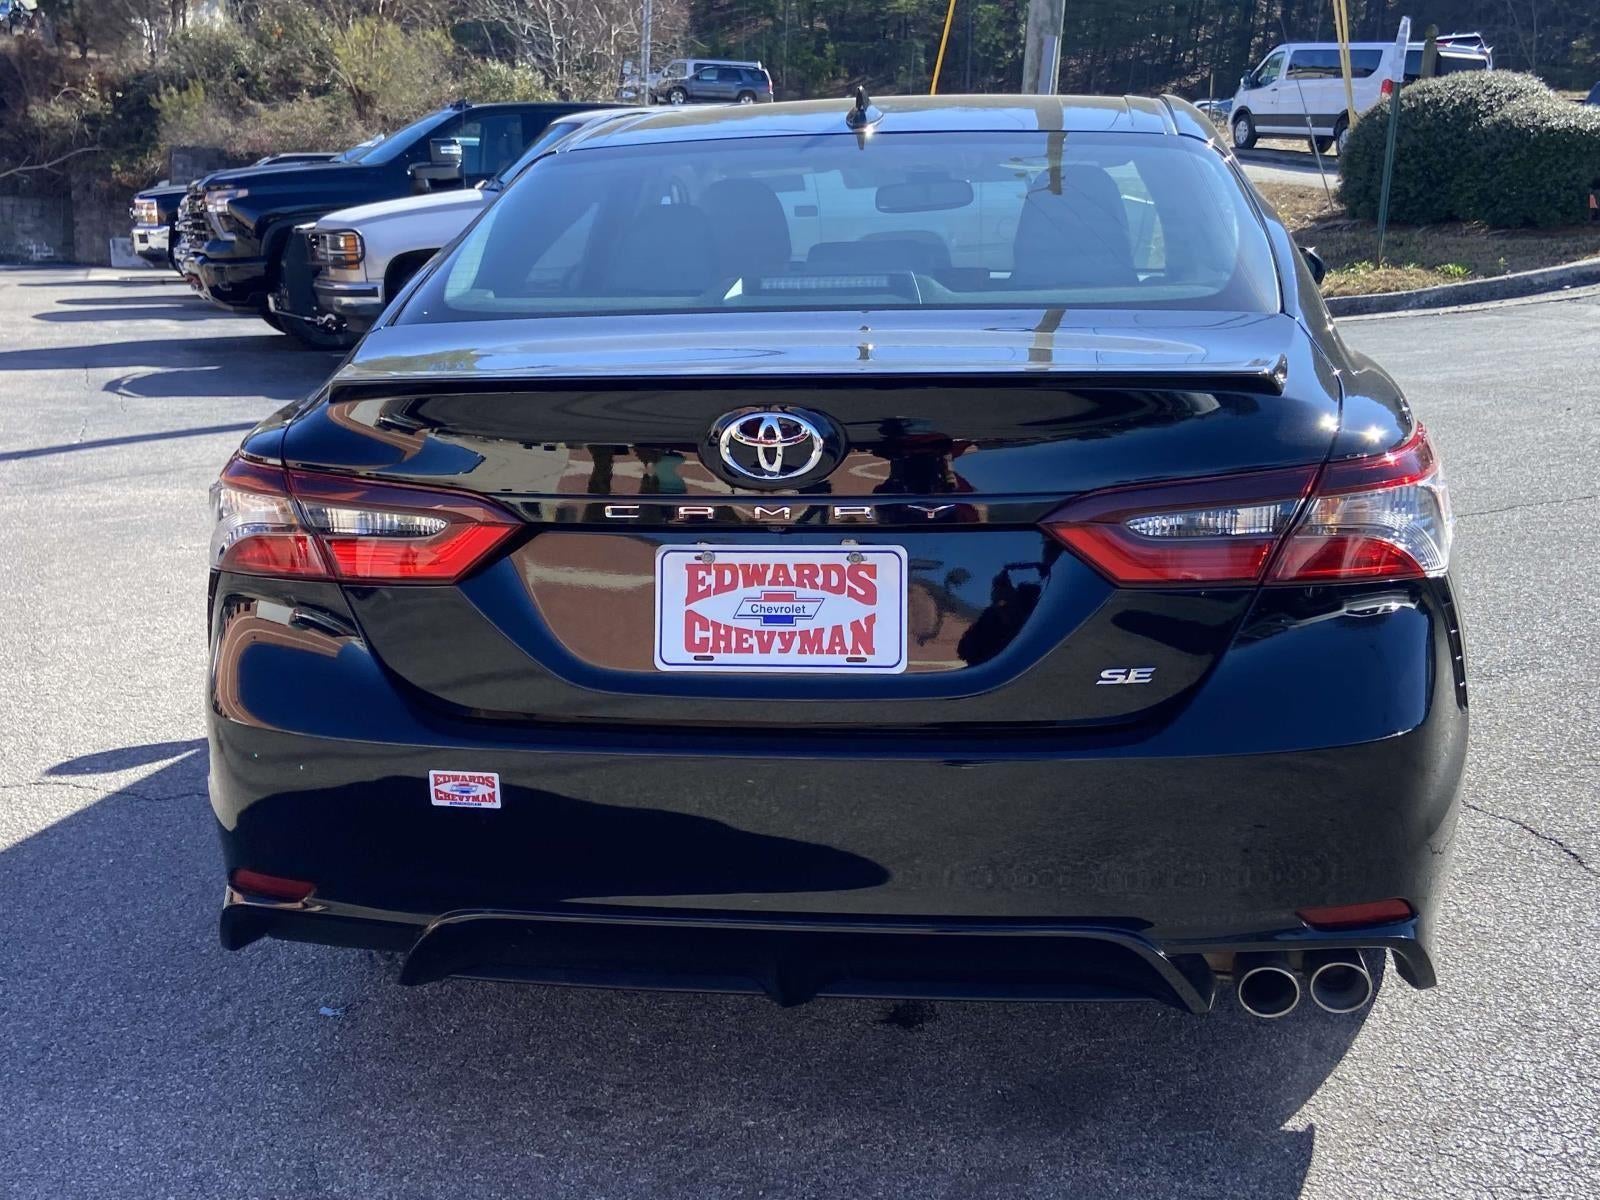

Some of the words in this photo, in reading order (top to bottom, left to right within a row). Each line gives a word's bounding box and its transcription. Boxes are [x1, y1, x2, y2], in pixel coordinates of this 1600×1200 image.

[605, 504, 955, 519] CAMRY
[685, 563, 877, 606] EDWARDS
[751, 603, 806, 614] Chevrolet
[684, 609, 876, 655] CHEVYMAN
[1096, 667, 1156, 685] SE
[433, 774, 496, 789] EDWARDS
[434, 788, 496, 803] CHEVYMAN
